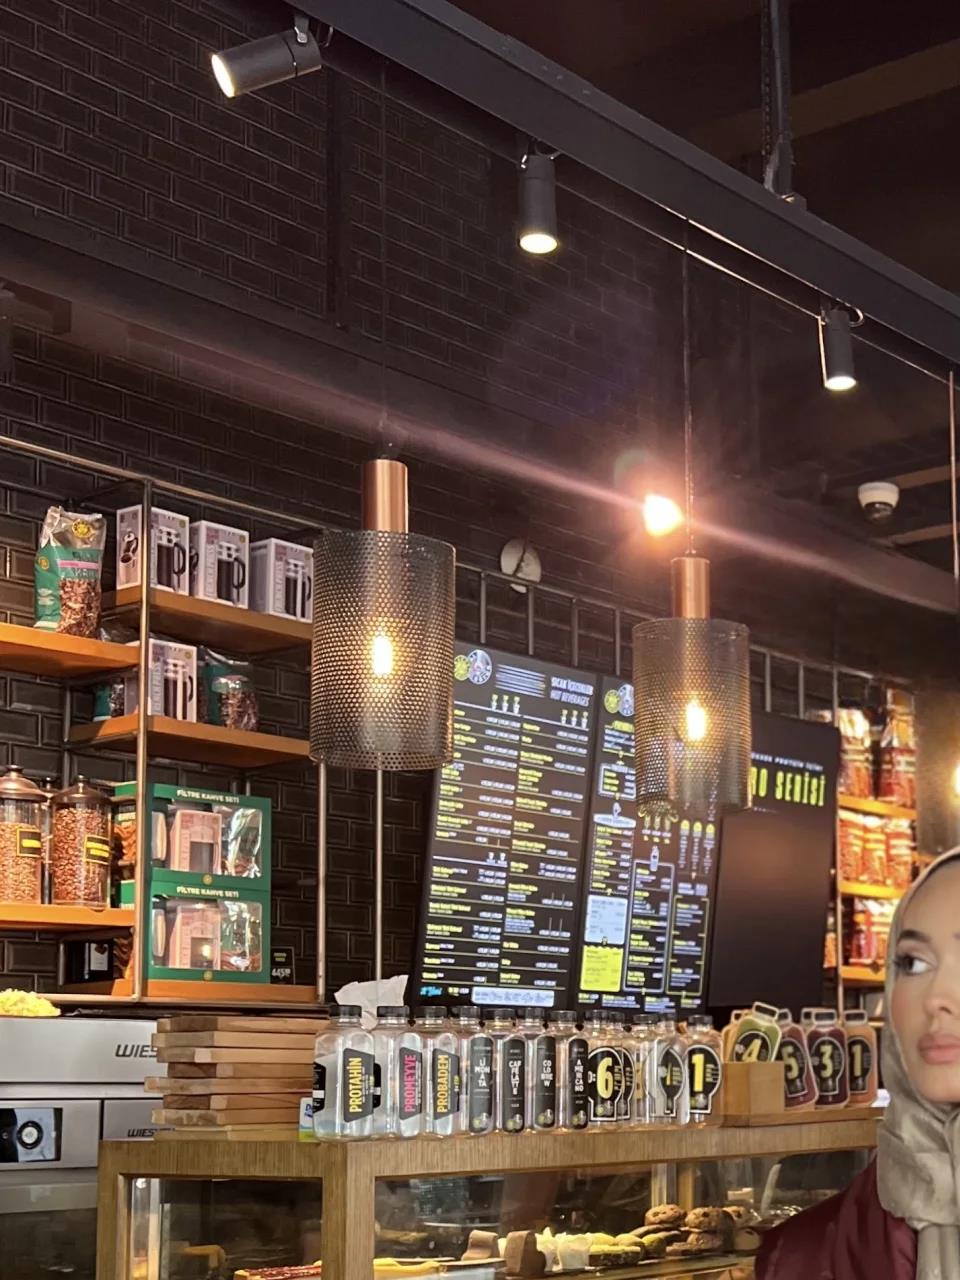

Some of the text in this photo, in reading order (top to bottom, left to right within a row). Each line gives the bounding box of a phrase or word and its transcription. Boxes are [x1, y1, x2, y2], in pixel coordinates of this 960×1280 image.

[177, 789, 240, 804] FİLTRE KAHVE SETİ
[775, 770, 826, 807] SERİSİ
[176, 886, 239, 898] FİLTRE KAHVE SETİ
[742, 1038, 762, 1062] 4
[781, 1044, 799, 1080] 5
[819, 1044, 834, 1077] 3
[851, 1044, 862, 1077] 1
[346, 1057, 363, 1113] PROTAHİN
[404, 1054, 417, 1112] PROMEYVE
[436, 1054, 449, 1113] PROBADEM
[596, 1057, 614, 1099] 6
[691, 1053, 705, 1092] 1
